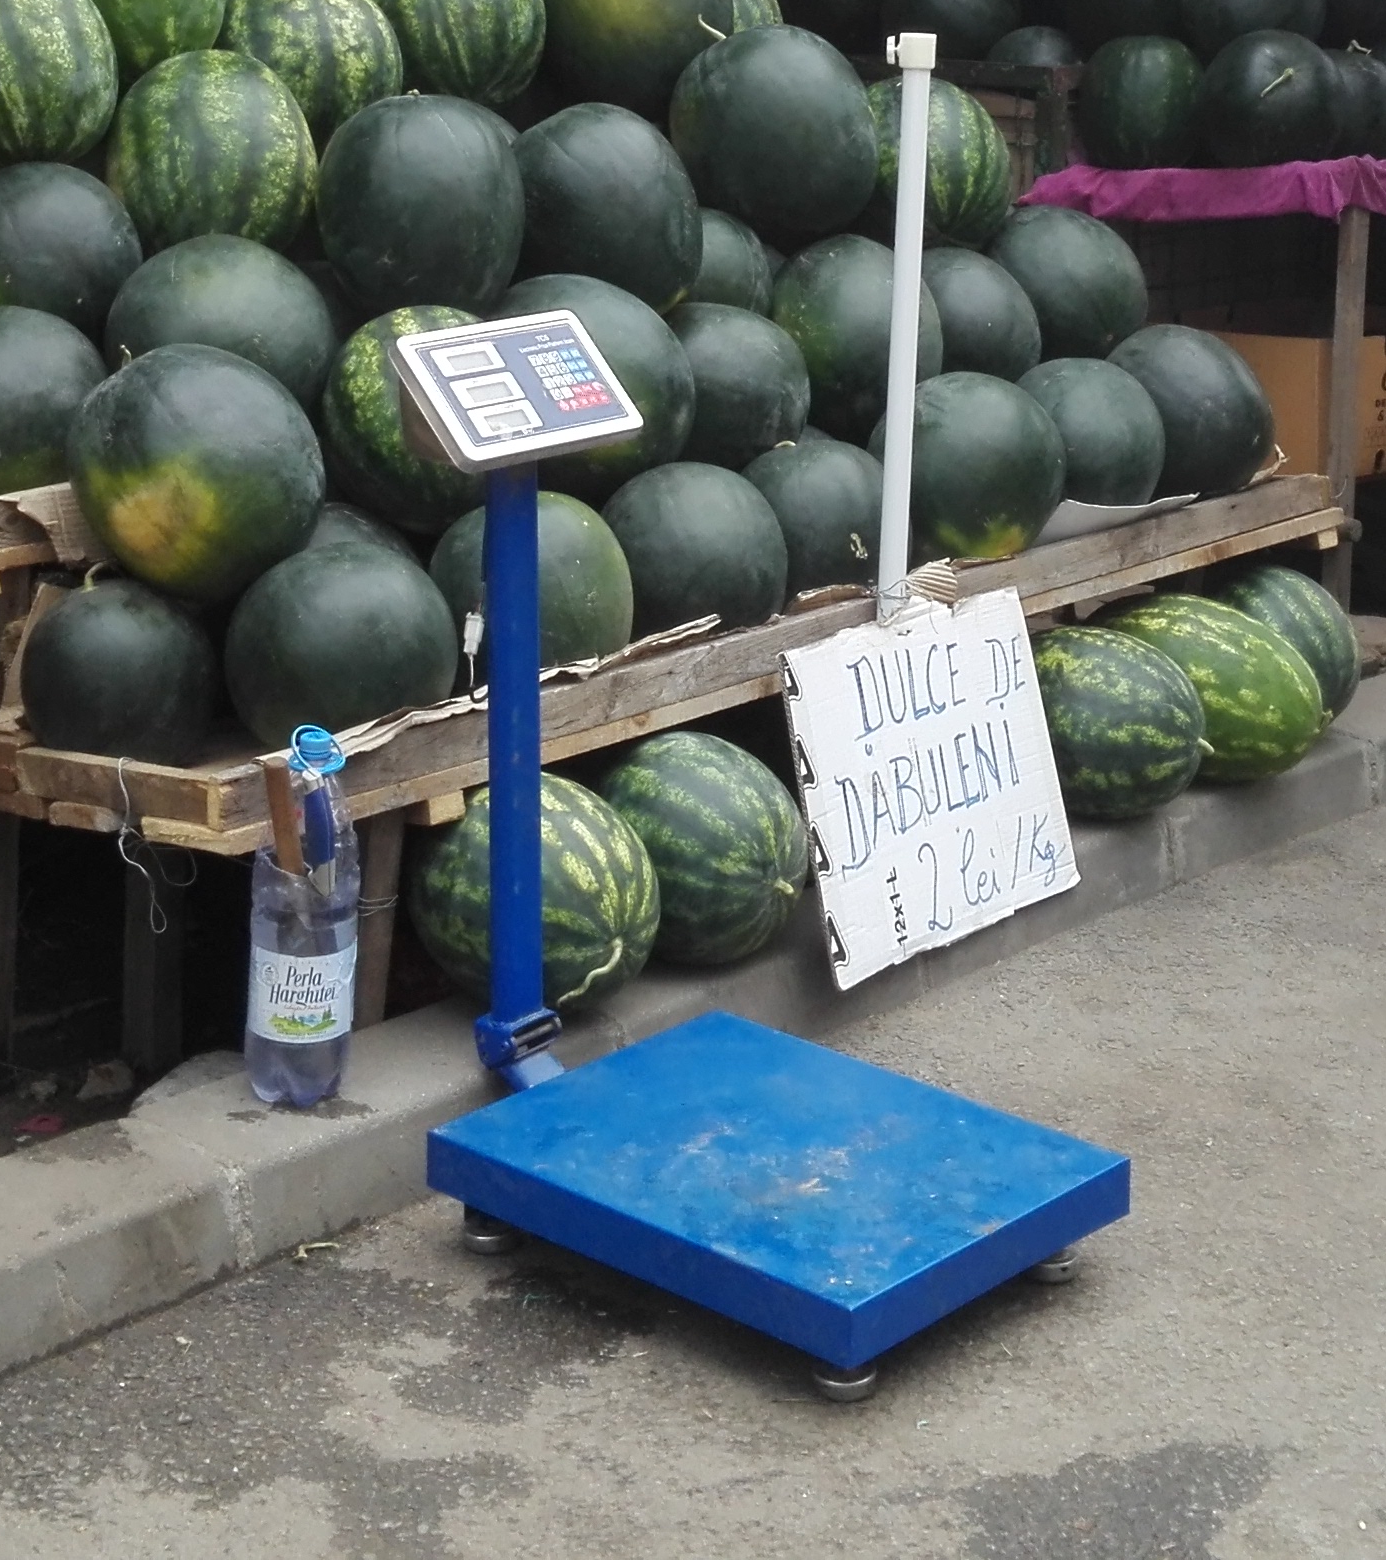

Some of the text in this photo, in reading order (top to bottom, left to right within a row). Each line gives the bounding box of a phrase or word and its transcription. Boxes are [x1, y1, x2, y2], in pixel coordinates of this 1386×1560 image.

[846, 633, 1026, 742] DULCE DE
[917, 842, 953, 932] 2
[285, 965, 323, 988] Perla
